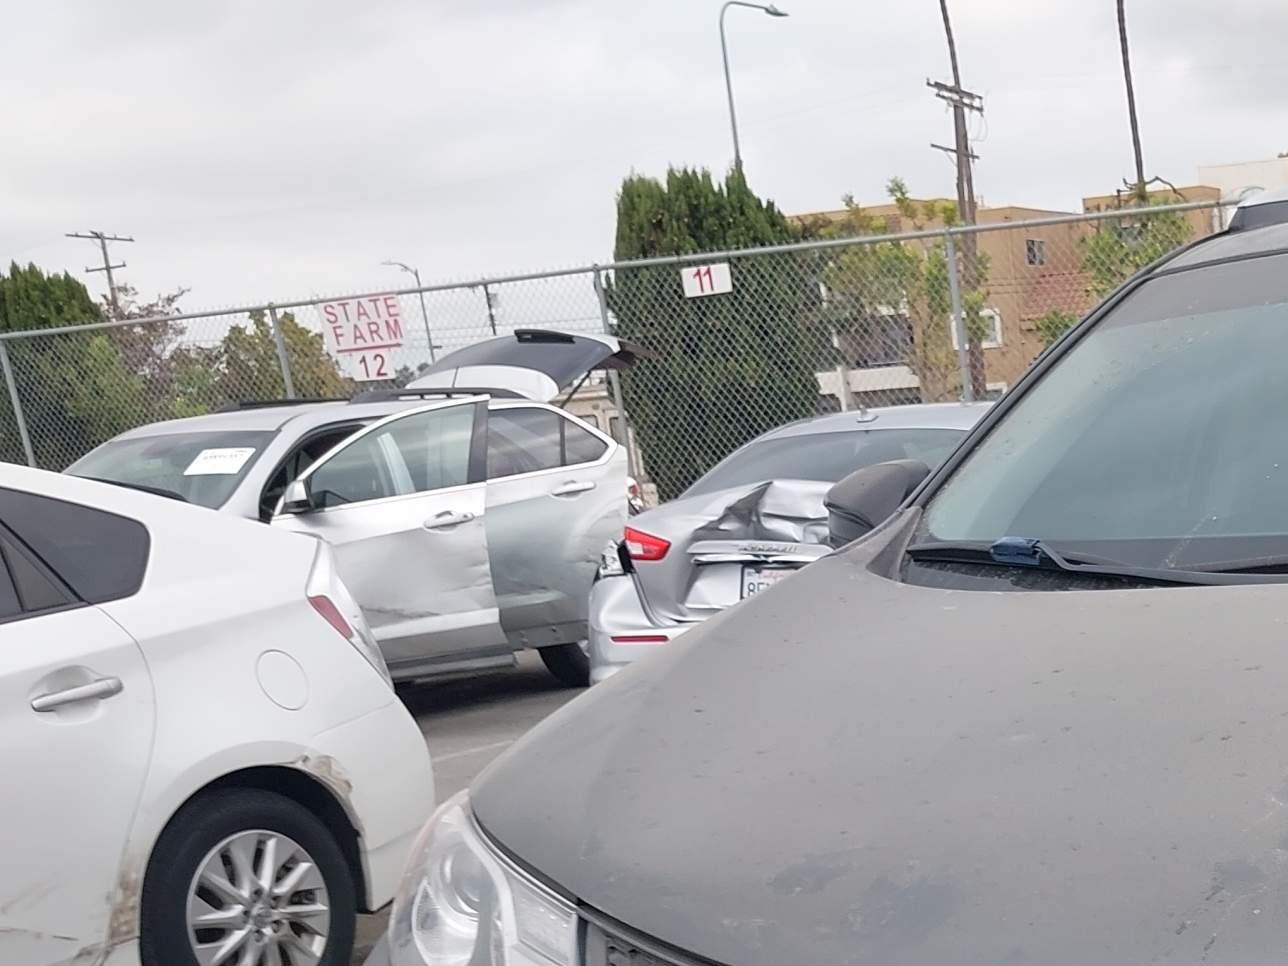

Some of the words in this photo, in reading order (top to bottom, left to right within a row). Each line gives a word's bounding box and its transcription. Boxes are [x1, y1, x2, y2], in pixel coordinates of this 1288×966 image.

[693, 266, 715, 293] 11
[323, 297, 400, 324] STATE
[332, 318, 404, 346] FARM
[359, 353, 388, 378] 12
